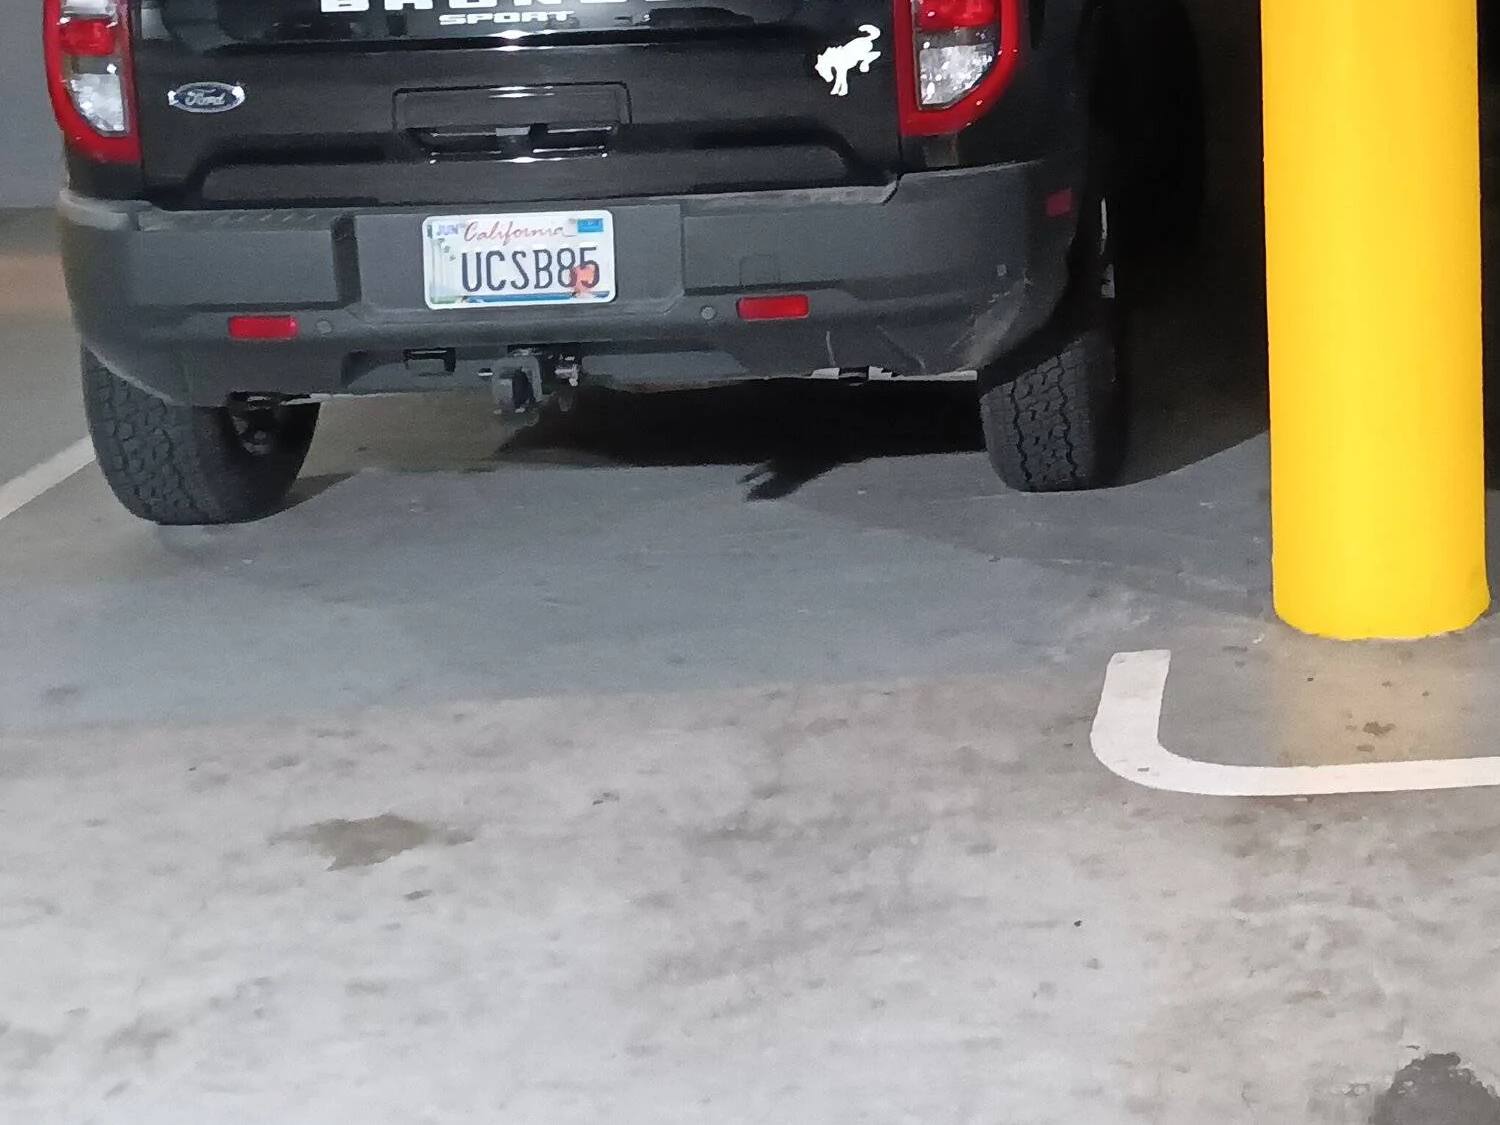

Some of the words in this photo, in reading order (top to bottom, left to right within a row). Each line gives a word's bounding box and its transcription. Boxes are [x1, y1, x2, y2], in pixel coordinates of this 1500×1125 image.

[439, 11, 574, 25] SPORT
[464, 221, 575, 246] California
[461, 246, 600, 293] UCSB85
